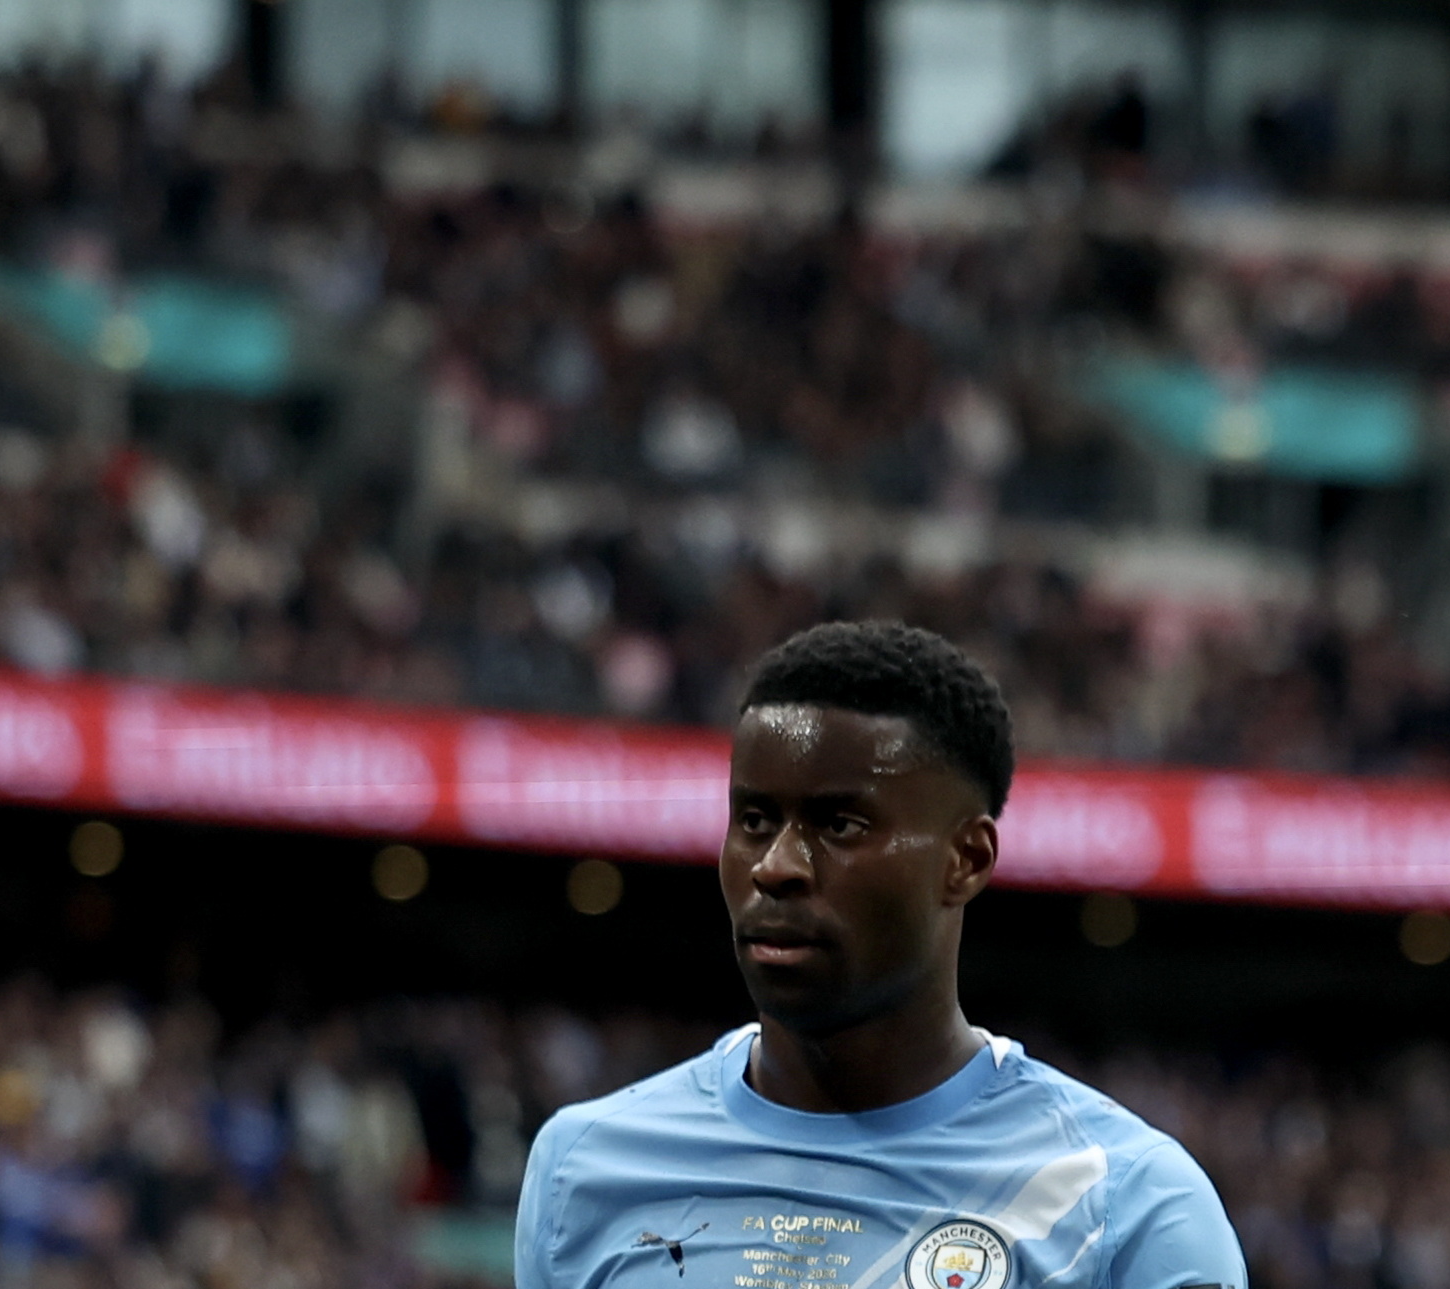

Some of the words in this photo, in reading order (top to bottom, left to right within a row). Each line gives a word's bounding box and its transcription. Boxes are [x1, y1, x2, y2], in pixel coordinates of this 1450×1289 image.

[742, 1216, 766, 1231] FA
[771, 1214, 810, 1232] CUP
[813, 1217, 864, 1234] FINAL
[774, 1231, 827, 1245] Chelsea
[922, 1226, 1002, 1261] MANCHESTER
[743, 1249, 820, 1266] Manchester
[826, 1253, 851, 1267] City
